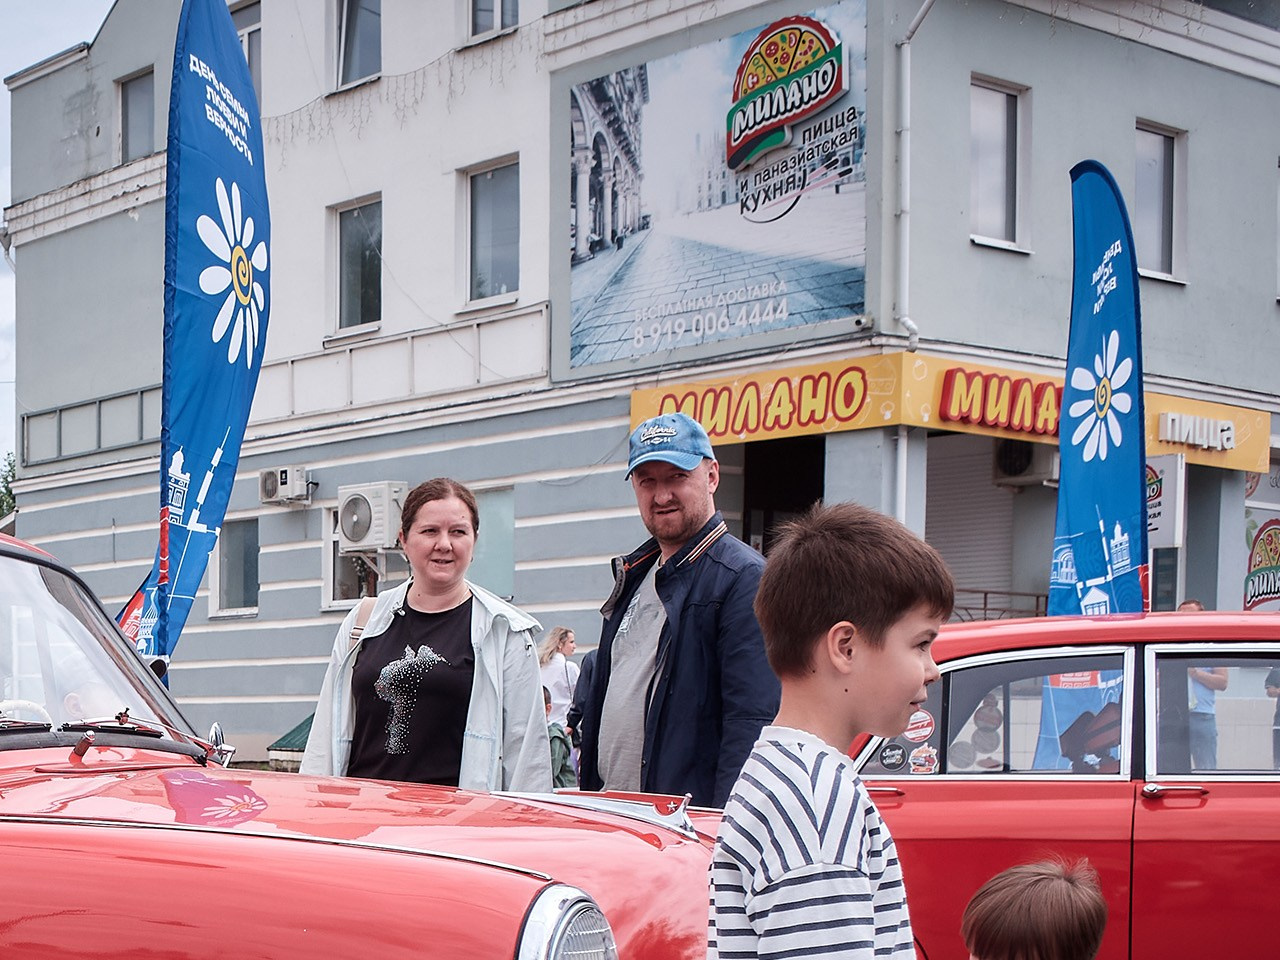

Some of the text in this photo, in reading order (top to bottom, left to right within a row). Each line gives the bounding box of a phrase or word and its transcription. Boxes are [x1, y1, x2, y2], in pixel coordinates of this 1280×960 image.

[189, 54, 219, 91] ДЕНЬ
[206, 85, 240, 132] ЛЮБВИ
[732, 59, 837, 145] МИЛАНО
[801, 106, 857, 145] пицца
[205, 103, 253, 166] ВЕРНОСТИ
[740, 126, 858, 193] и паназиатская
[633, 297, 790, 348] 8 919 006 4444
[634, 280, 788, 322] БЕСПЛАТНАЯ ДОСТАВКА
[939, 367, 1064, 435] МИЛА
[1161, 413, 1235, 450] пицца
